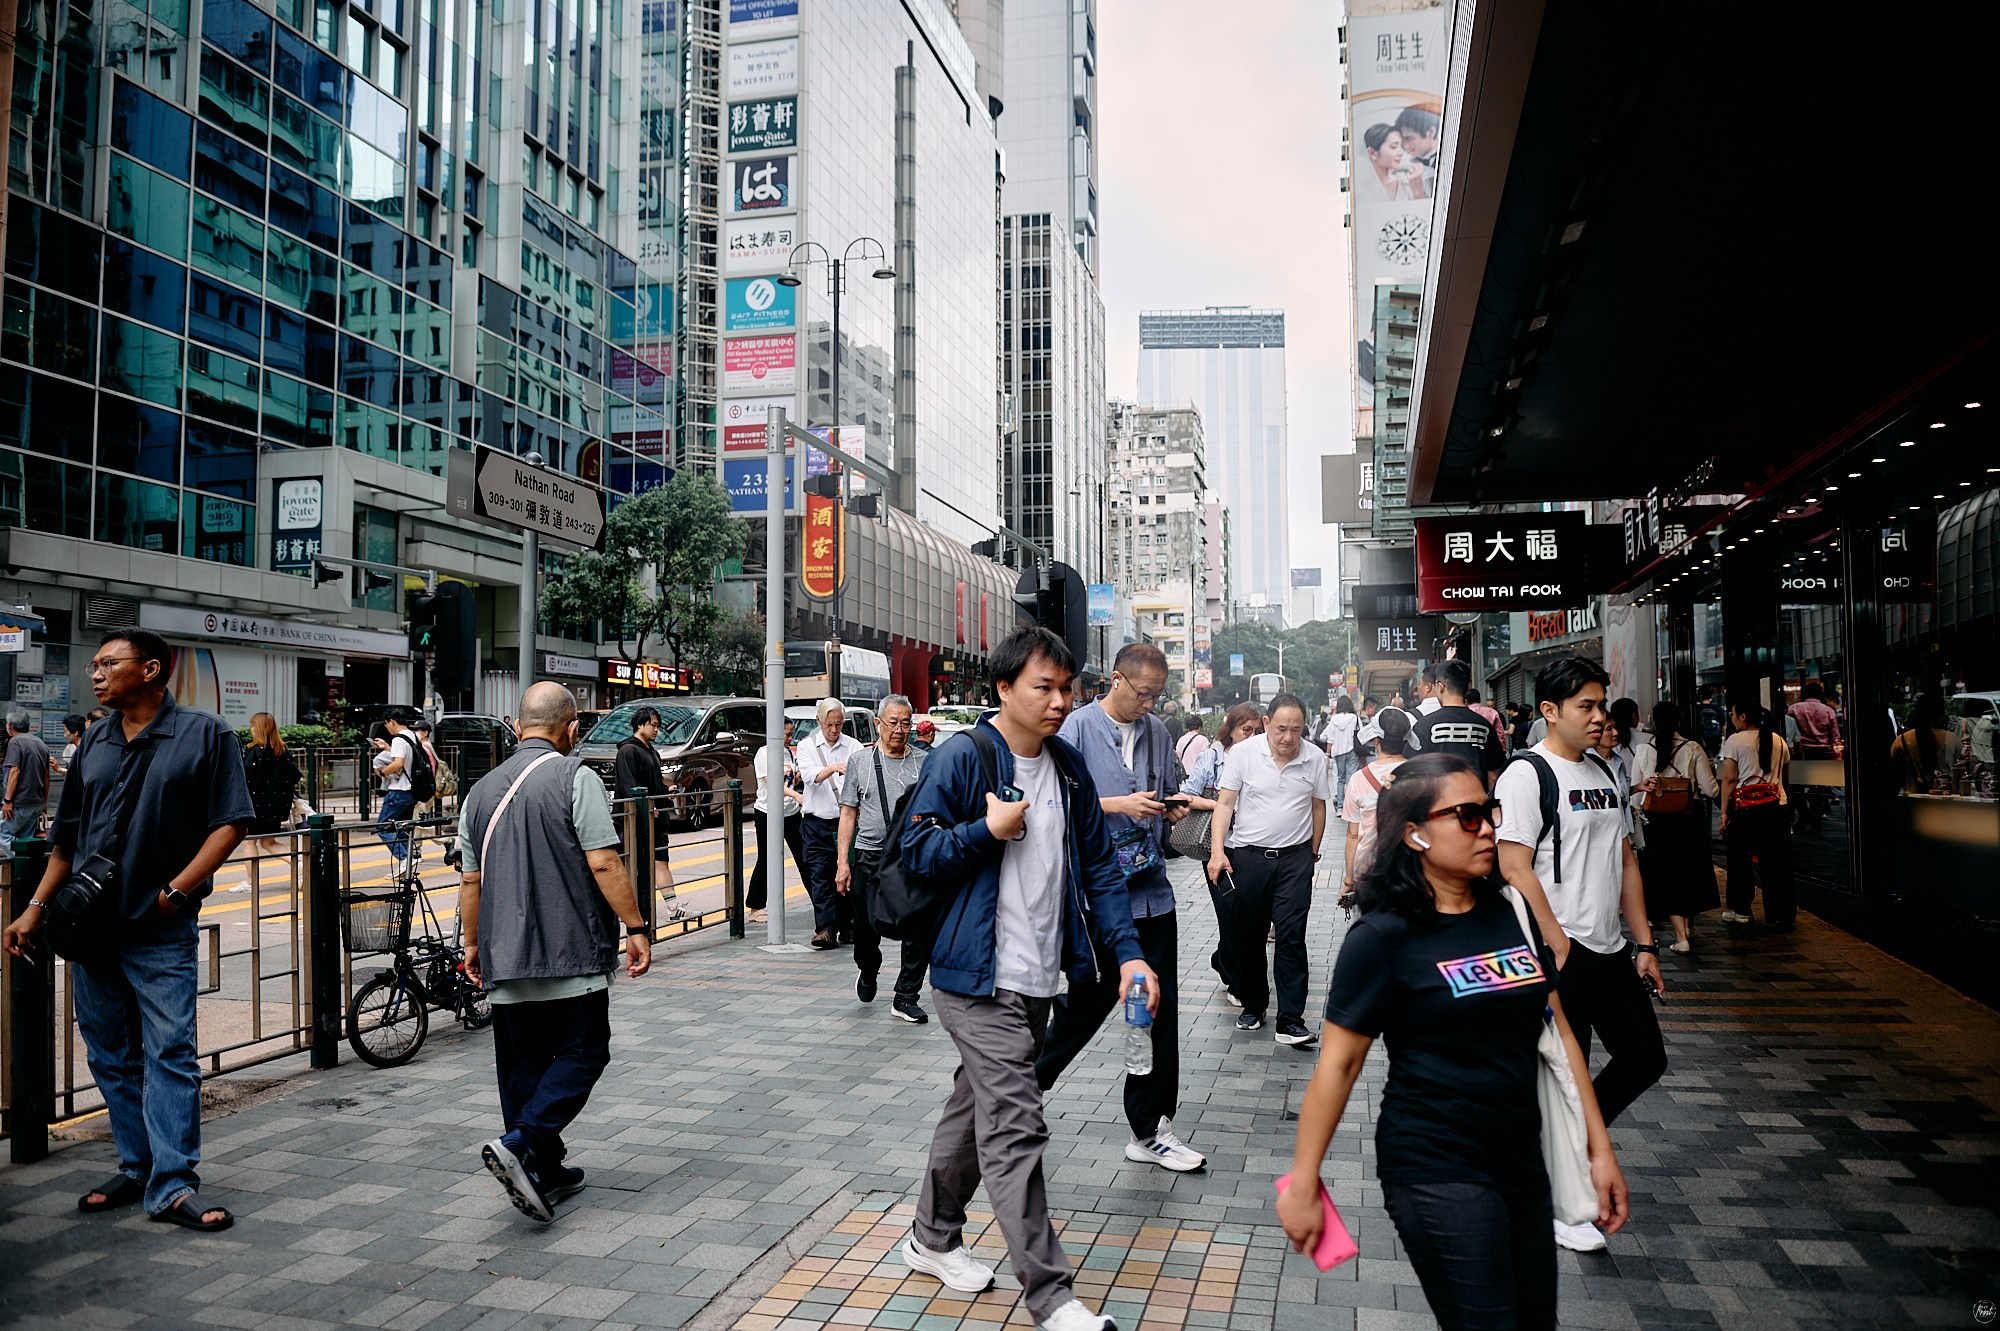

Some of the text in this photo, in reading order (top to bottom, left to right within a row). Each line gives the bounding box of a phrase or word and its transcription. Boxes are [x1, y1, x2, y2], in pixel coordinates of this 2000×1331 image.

[752, 9, 774, 19] TO LET
[1376, 31, 1424, 61] 周生生
[731, 101, 794, 135] 彩薈軒
[742, 161, 781, 203] は
[730, 230, 792, 250] はま寿司
[730, 247, 792, 258] HAMA-SUSHI
[753, 309, 790, 318] FITNESS
[514, 469, 575, 504] Nathan Road
[743, 473, 768, 486] 23
[728, 487, 763, 496] NATHAN
[526, 499, 563, 530] 彌敦道
[1359, 498, 1373, 510] Cho
[812, 506, 833, 560] 酒家
[276, 538, 320, 562] 彩薈軒
[1443, 529, 1558, 563] 周大福
[1442, 584, 1562, 599] CHOW TAI FOOK
[280, 627, 301, 639] BANK
[302, 631, 313, 641] OF
[313, 631, 337, 643] CHINA
[1377, 627, 1417, 652] 周生生
